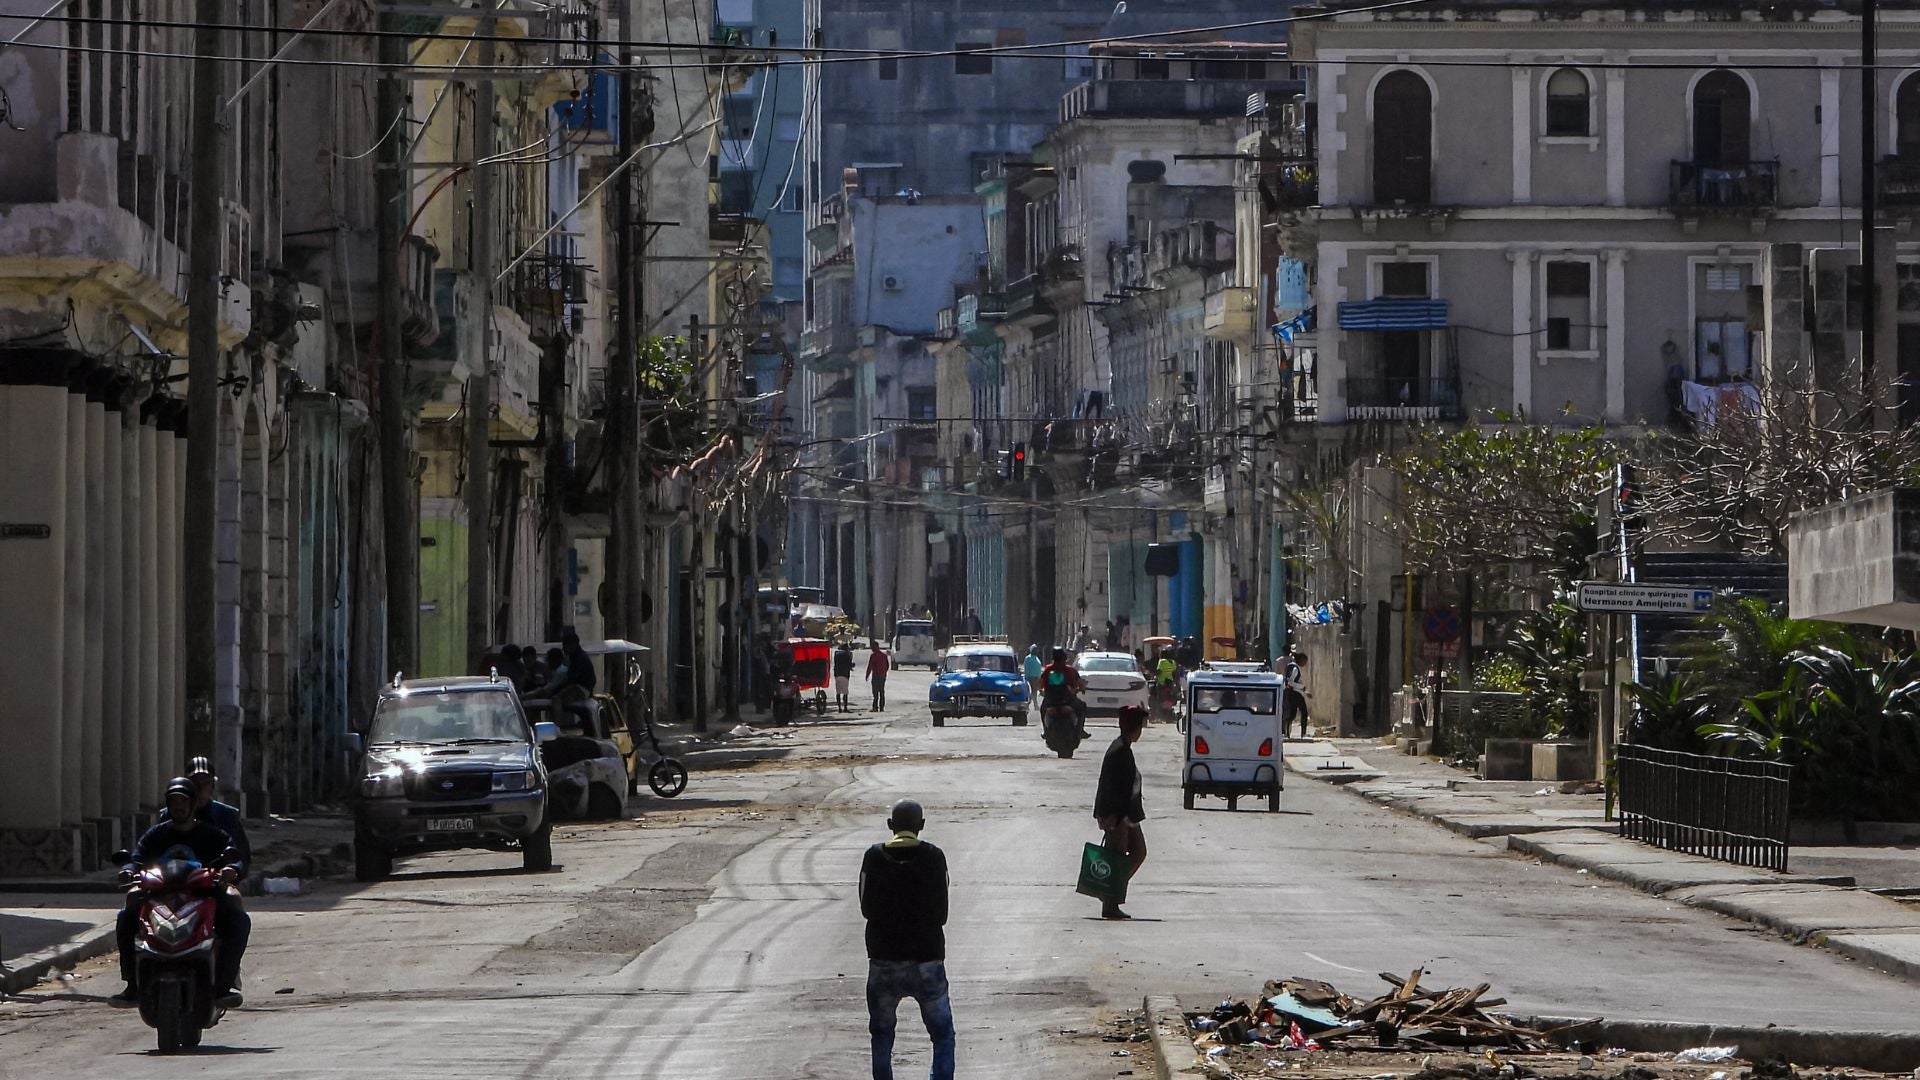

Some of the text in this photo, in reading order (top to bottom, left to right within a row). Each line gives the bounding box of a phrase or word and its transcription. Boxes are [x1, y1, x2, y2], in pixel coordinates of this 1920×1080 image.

[1584, 588, 1617, 597] hospital
[1584, 597, 1687, 609] Hermanos Ameijeiras
